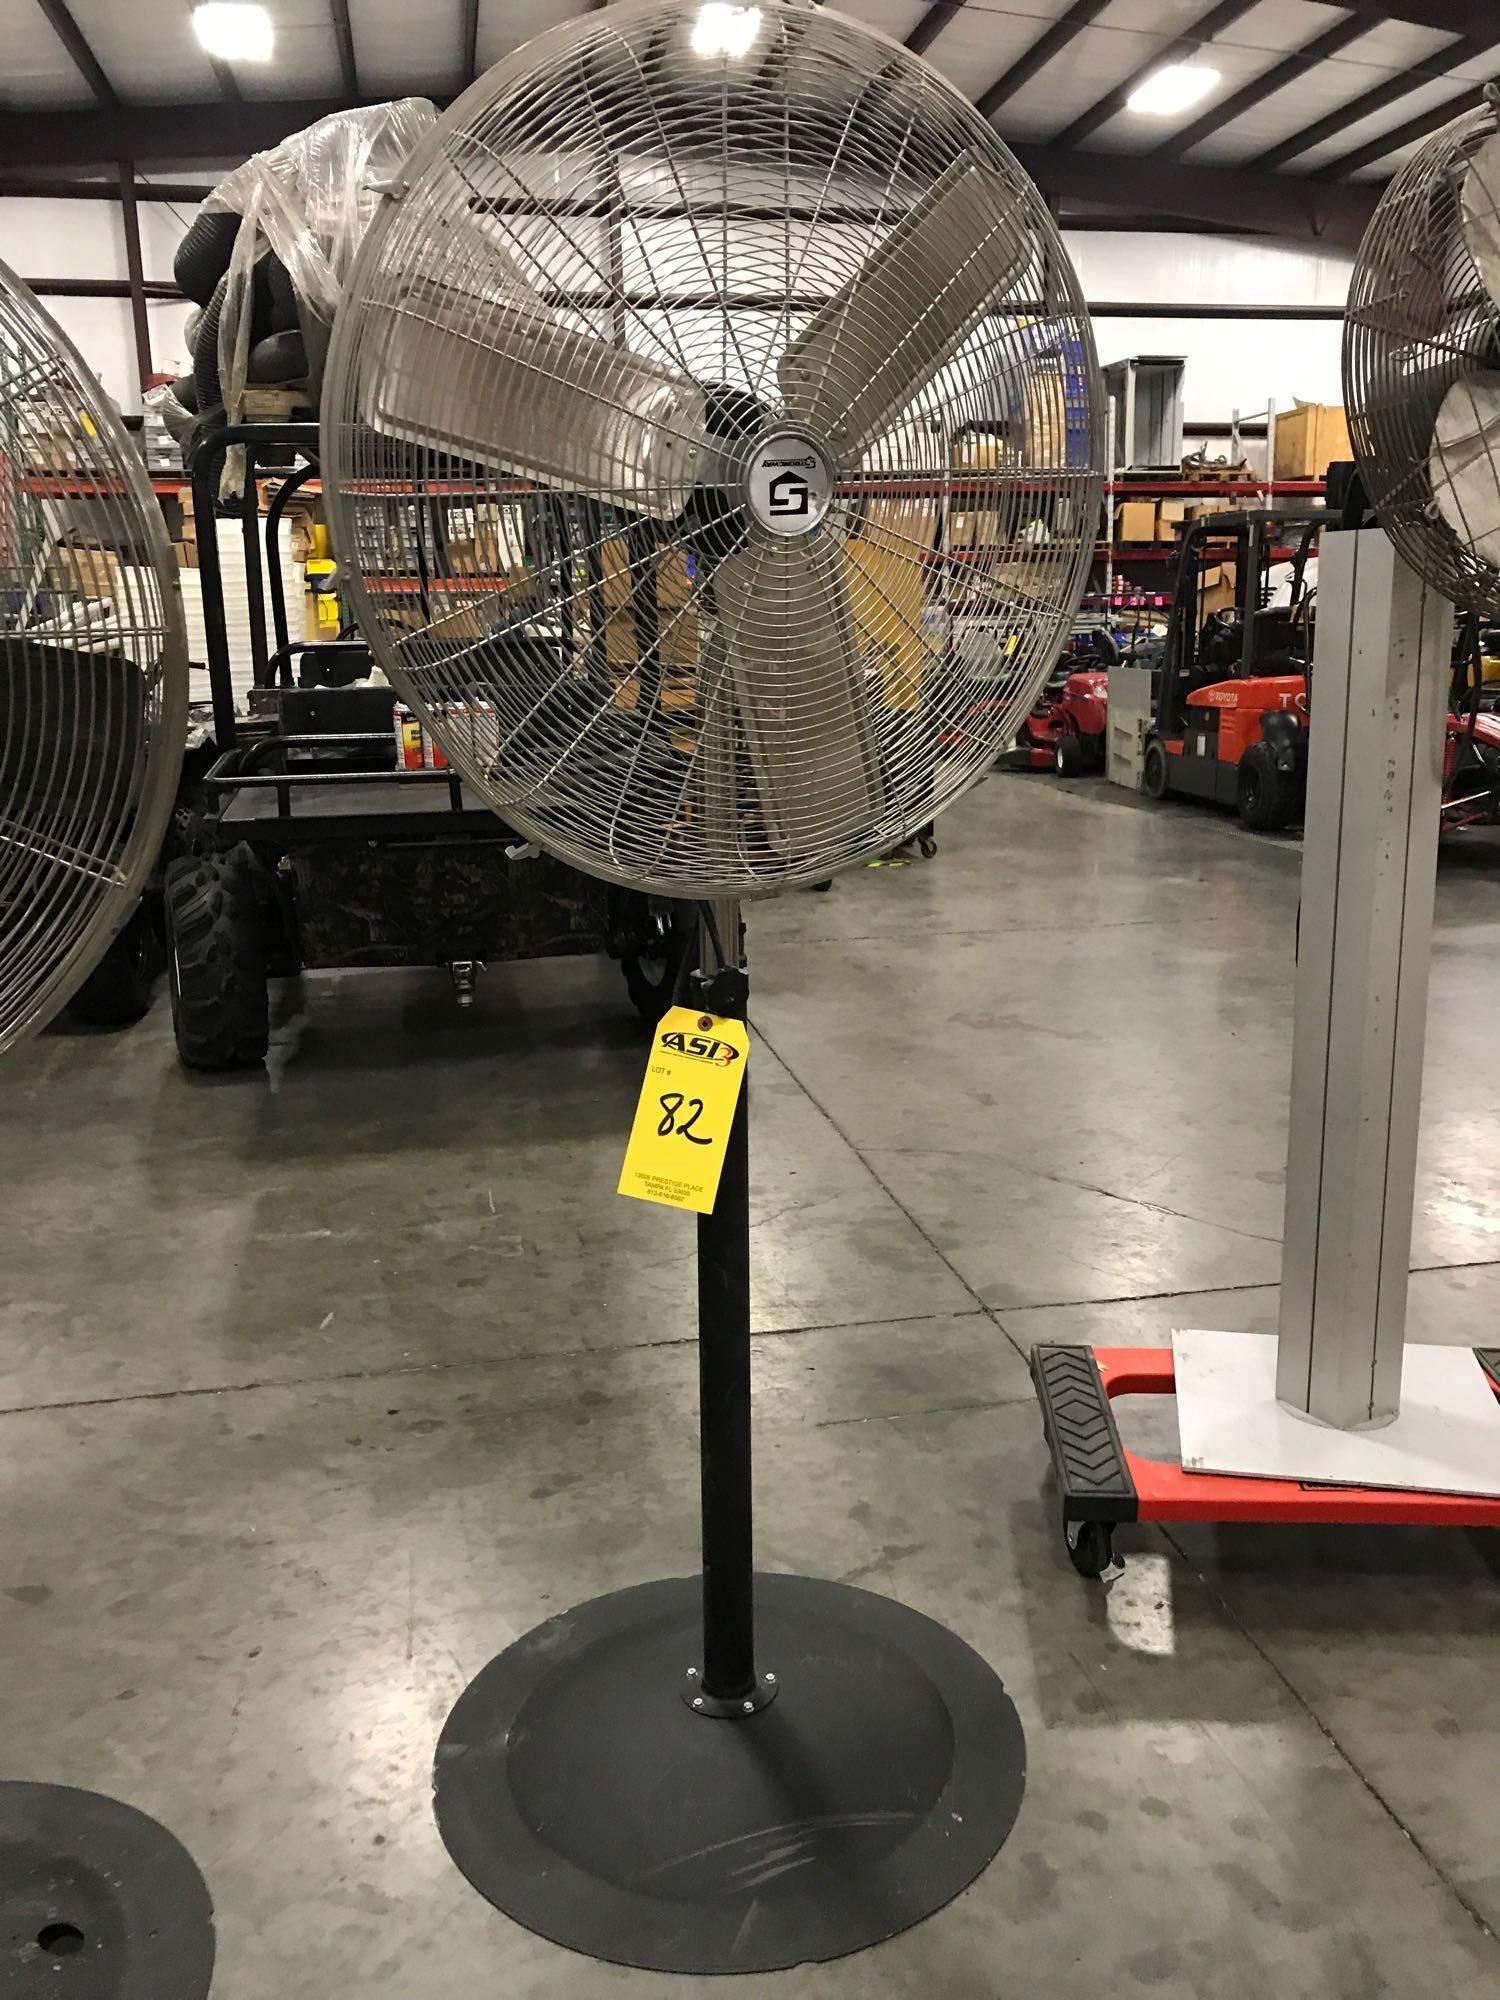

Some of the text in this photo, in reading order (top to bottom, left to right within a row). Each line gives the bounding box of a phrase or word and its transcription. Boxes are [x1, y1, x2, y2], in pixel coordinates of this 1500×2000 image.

[1215, 691, 1238, 703] TOYOTA
[651, 1066, 665, 1074] LOT
[657, 1093, 713, 1145] 82
[644, 1181, 664, 1190] TAMPA
[652, 1175, 683, 1187] PRESTIGE
[683, 1183, 704, 1192] PLACE
